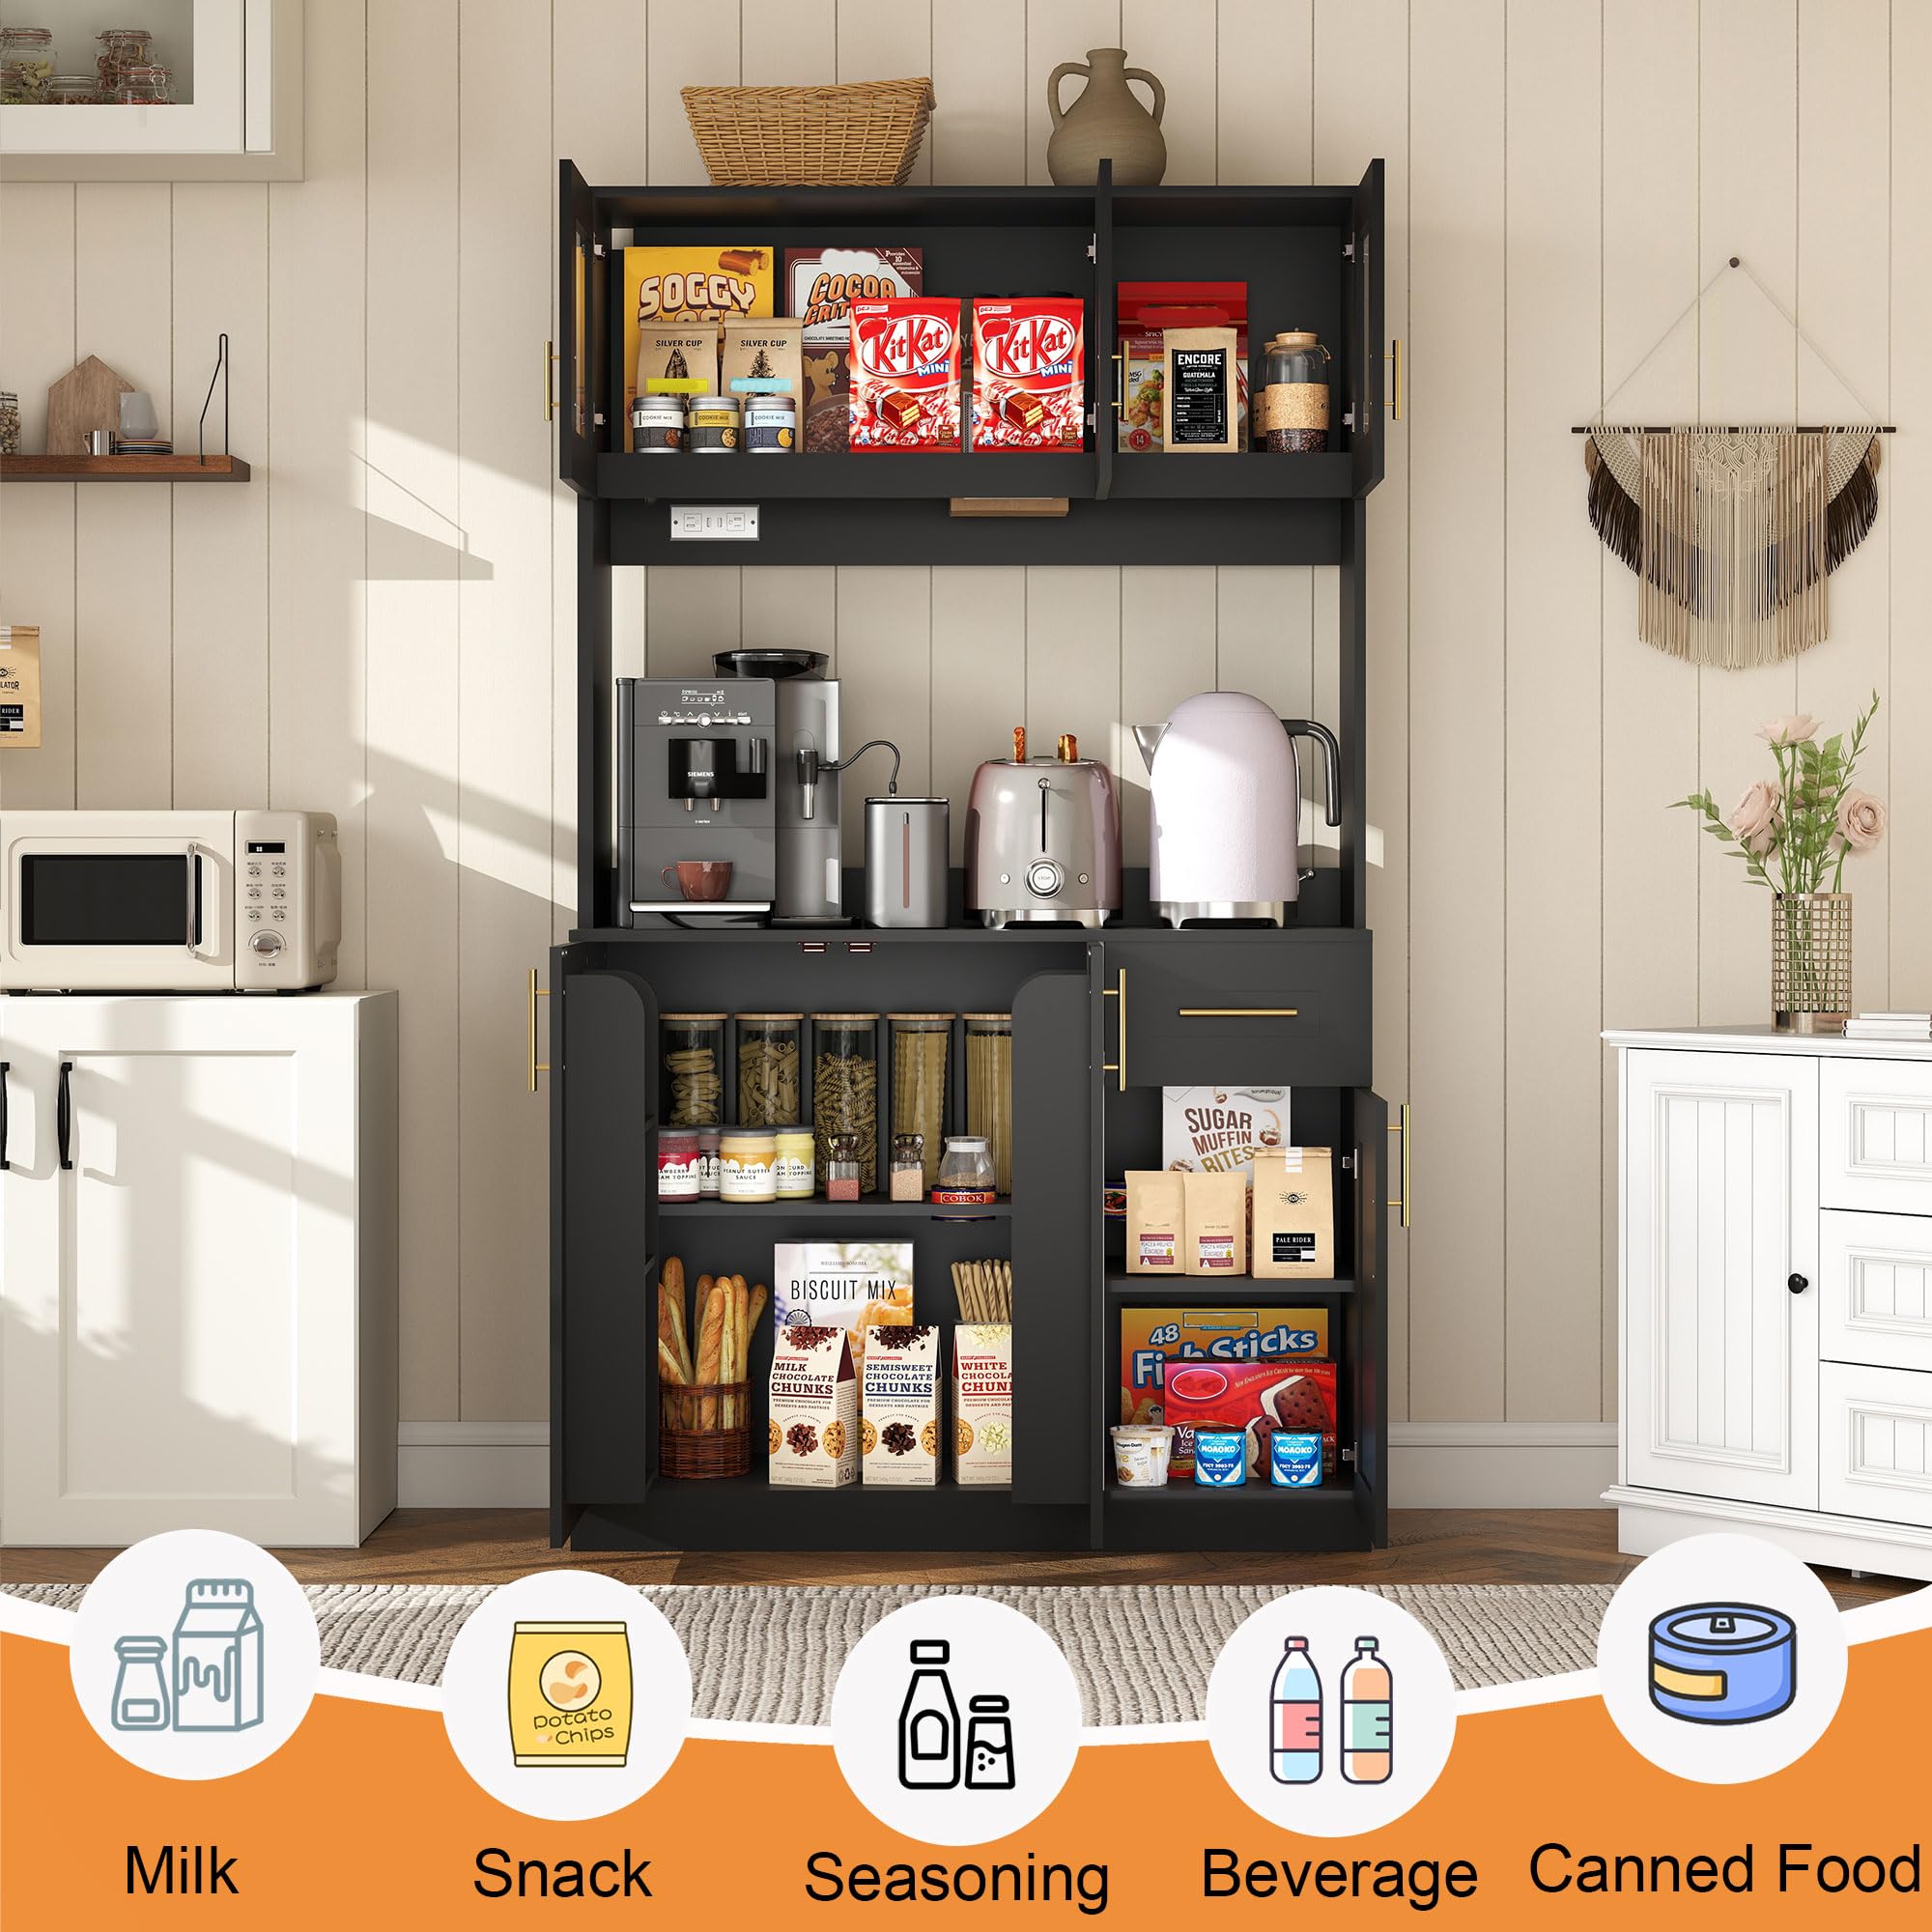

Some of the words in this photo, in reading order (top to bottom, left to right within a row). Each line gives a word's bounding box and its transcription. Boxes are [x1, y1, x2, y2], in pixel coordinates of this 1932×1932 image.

[808, 272, 896, 306] COCOA
[638, 271, 755, 323] SOGGY
[1178, 354, 1222, 365] ENCORE
[1135, 435, 1145, 444] 14
[1184, 1108, 1253, 1134] SUGAR
[1191, 1130, 1252, 1156] MUFFIN
[1200, 1145, 1255, 1173] BITES
[942, 1194, 984, 1203] COBOK
[790, 1280, 858, 1300] BISCUIT
[867, 1280, 896, 1300] MIX
[1151, 1324, 1179, 1345] 48
[1211, 1327, 1315, 1357] Sticks
[774, 1362, 807, 1372] MILK
[866, 1363, 933, 1372] SEMISWEET
[960, 1362, 1008, 1371] WHITE
[773, 1373, 834, 1382] CHOCOLATE
[771, 1381, 834, 1394] CHUNKS
[865, 1382, 932, 1393] CHUNKS
